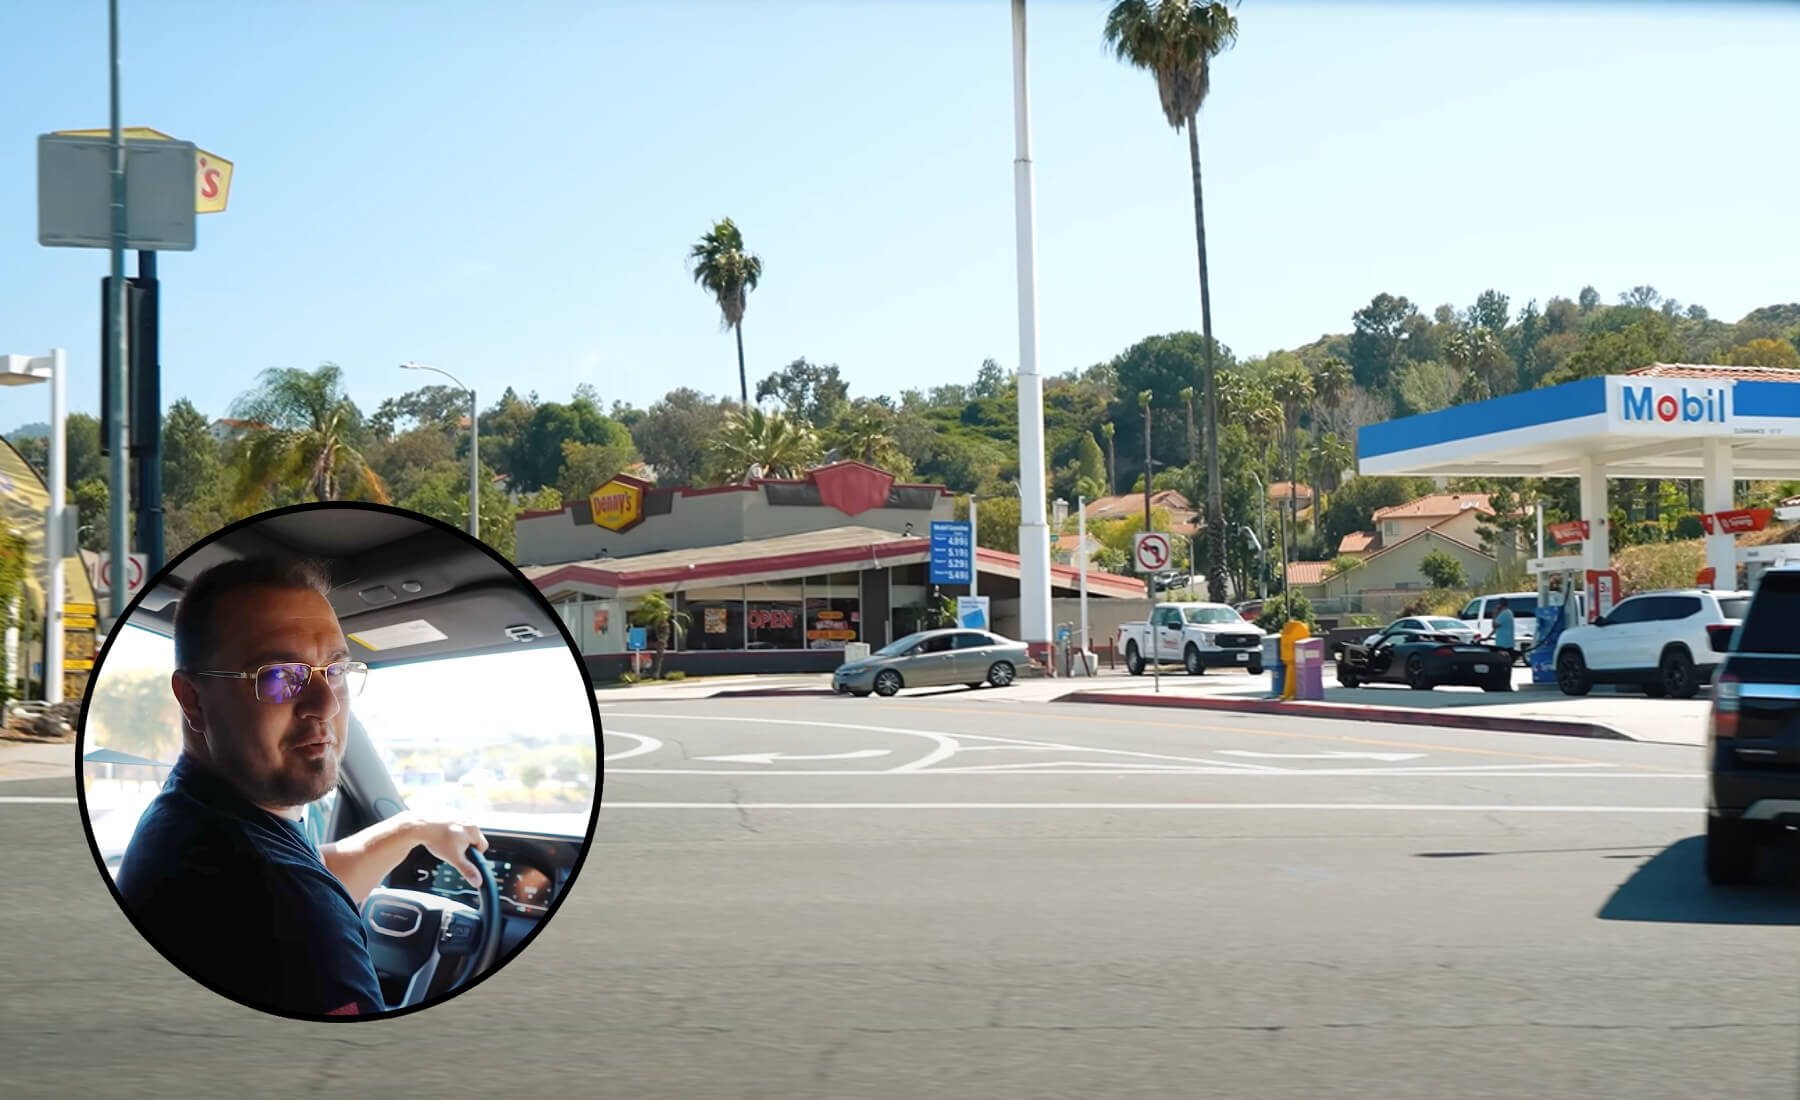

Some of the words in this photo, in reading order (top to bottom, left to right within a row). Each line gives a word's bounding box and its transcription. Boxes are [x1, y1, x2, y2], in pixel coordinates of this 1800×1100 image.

[1623, 386, 1726, 423] Mobil
[593, 491, 632, 517] Denny's
[749, 610, 793, 629] OPEN
